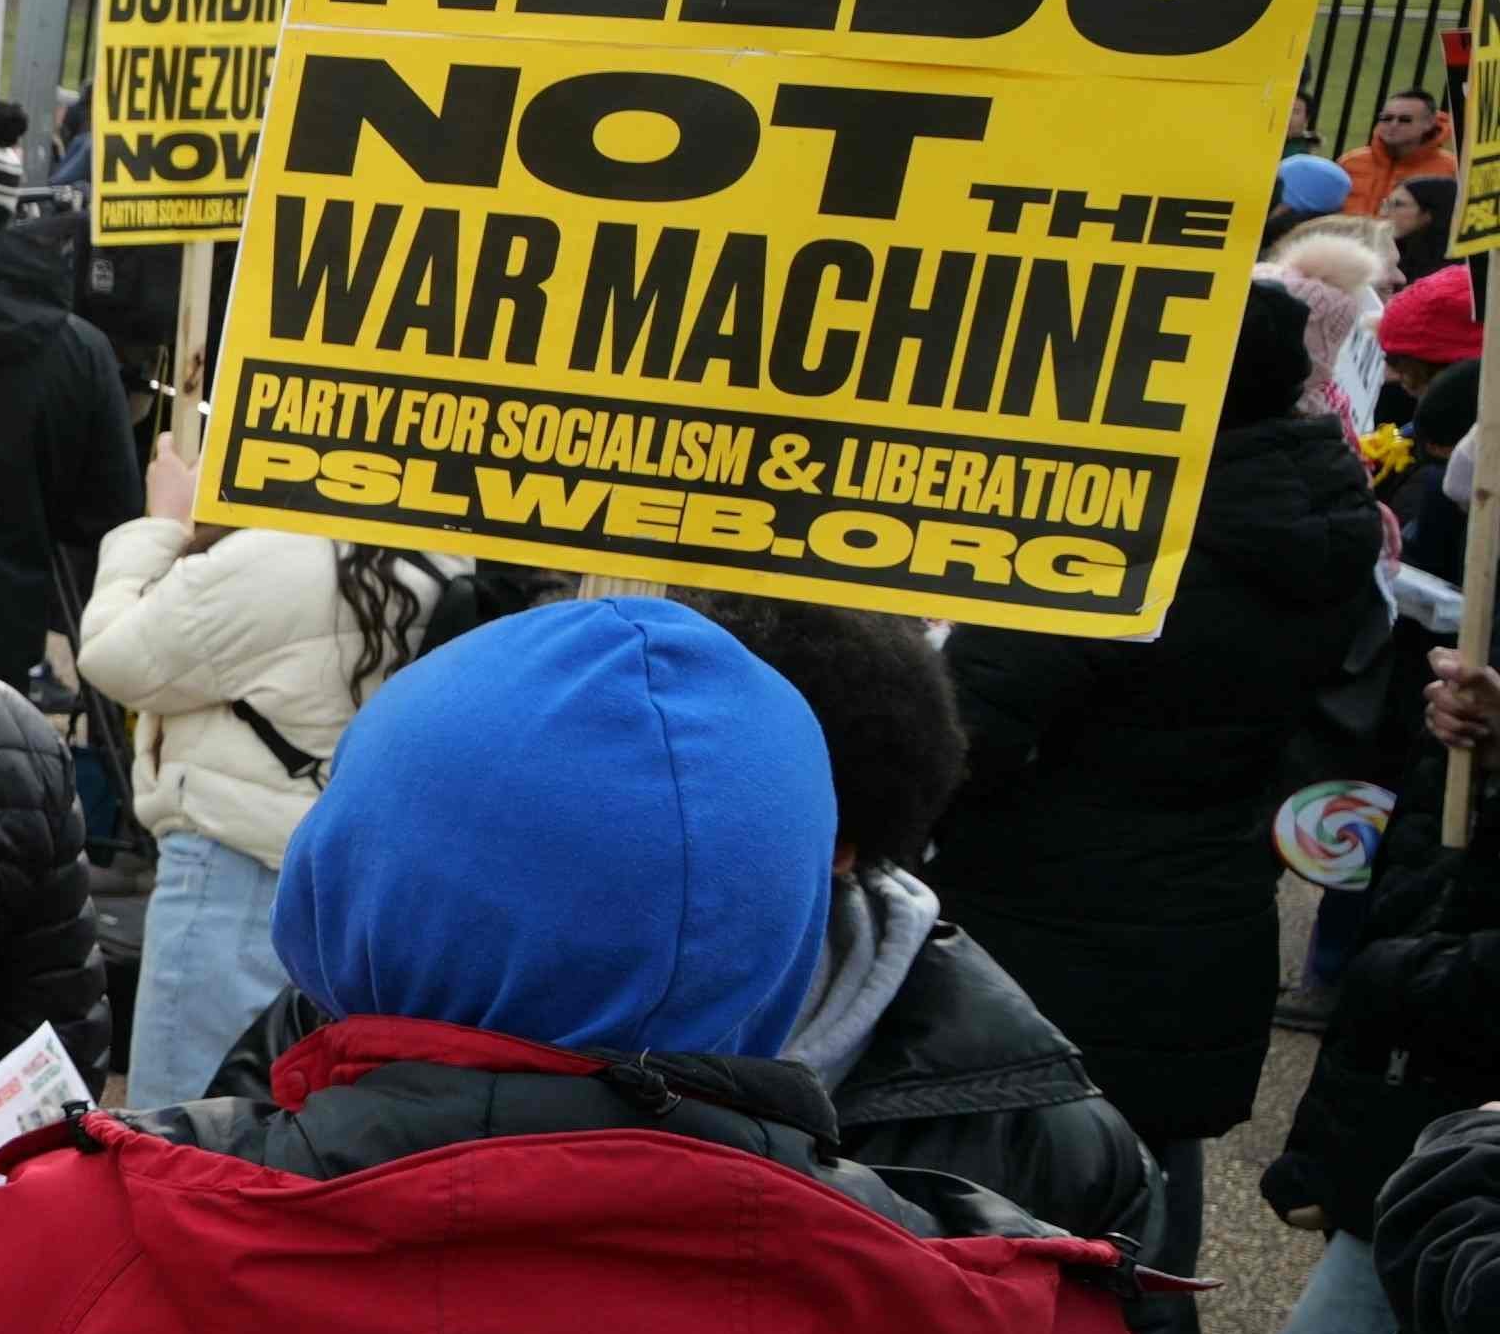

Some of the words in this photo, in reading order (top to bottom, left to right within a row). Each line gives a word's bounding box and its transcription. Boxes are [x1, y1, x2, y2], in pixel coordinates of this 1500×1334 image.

[284, 55, 993, 220] NOT
[969, 183, 1234, 249] THE
[271, 195, 560, 365] WAR
[569, 222, 1215, 432] MACHINE
[234, 444, 1127, 595] PSLWEB.ORG
[245, 373, 394, 442] PARTY
[393, 390, 489, 454] FOR
[491, 401, 754, 485] SOCIALISM
[759, 434, 825, 493] &
[833, 438, 1151, 531] LIBERATION
